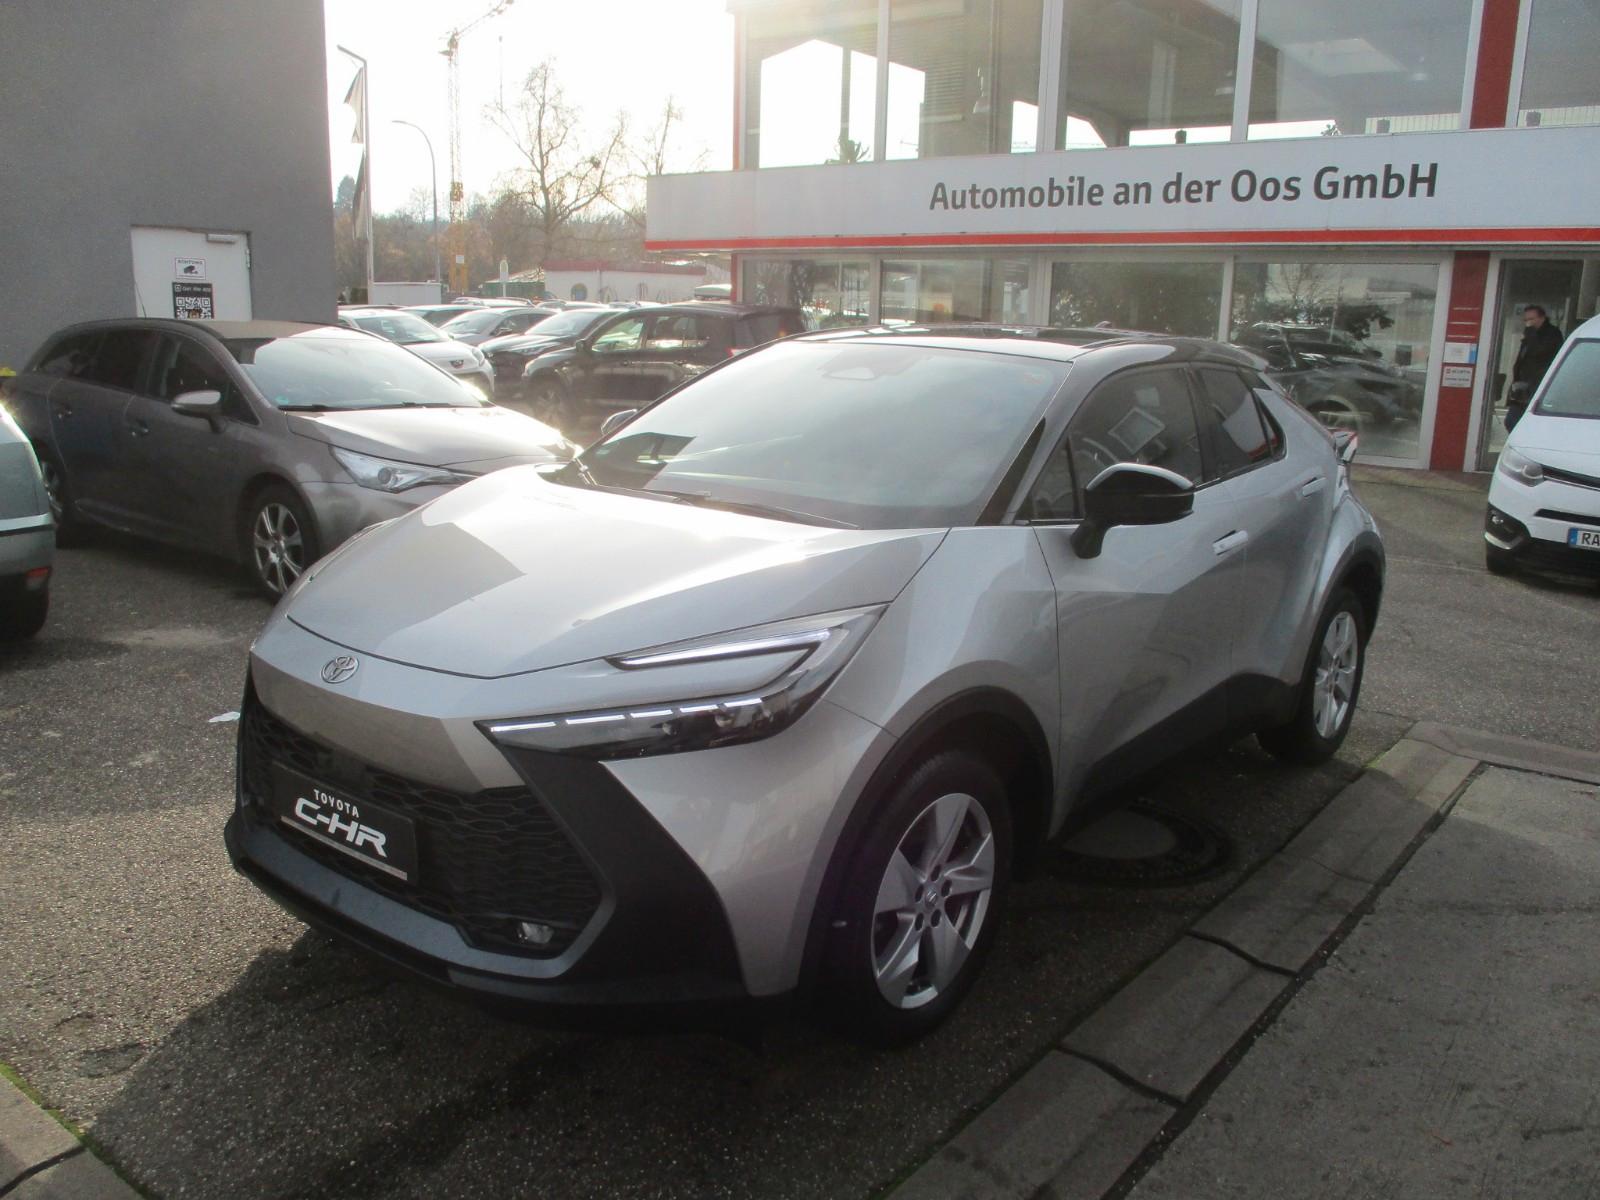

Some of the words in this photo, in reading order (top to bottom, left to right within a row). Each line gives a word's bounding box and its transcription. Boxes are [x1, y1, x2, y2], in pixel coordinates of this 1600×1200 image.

[929, 175, 1105, 211] Automobile
[1112, 180, 1153, 207] an
[1161, 171, 1221, 204] der
[1230, 168, 1302, 202] Oos
[1313, 162, 1438, 201] GmbH
[1581, 532, 1600, 547] RA
[313, 788, 360, 818] TOYOTA
[295, 797, 388, 858] C-HR
